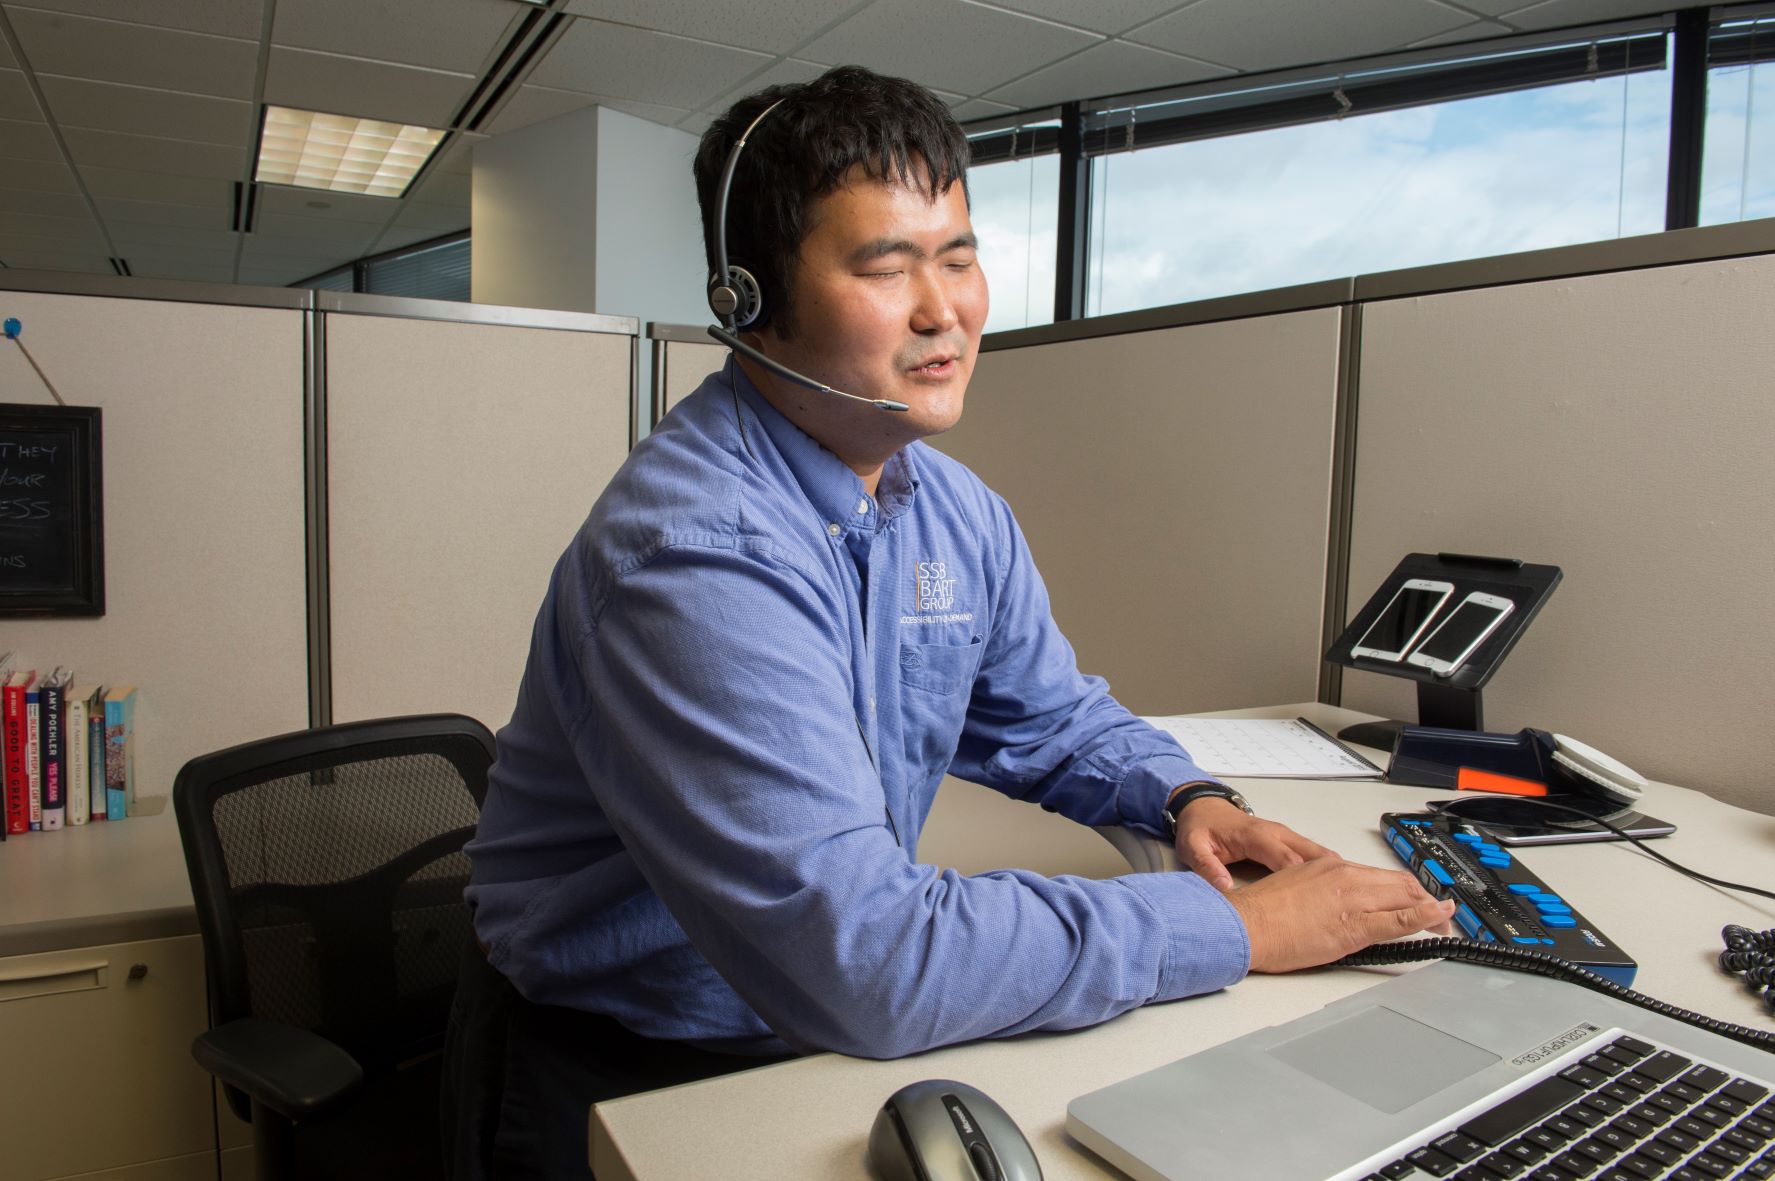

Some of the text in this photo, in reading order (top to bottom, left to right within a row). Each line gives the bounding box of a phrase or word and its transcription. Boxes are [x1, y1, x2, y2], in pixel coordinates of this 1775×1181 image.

[920, 562, 946, 580] SSB
[921, 579, 957, 597] BART
[920, 597, 954, 610] GROUP
[48, 691, 57, 756] AMY POEHLER
[9, 721, 19, 752] GOOD
[30, 741, 38, 755] WITH
[10, 758, 20, 773] TO
[31, 755, 39, 775] PEOPLE
[31, 776, 39, 788] YOU
[49, 762, 58, 802] YES PLEASE
[11, 779, 21, 816] GREAT
[32, 788, 40, 804] CAN'T
[1587, 1145, 1600, 1153] H
